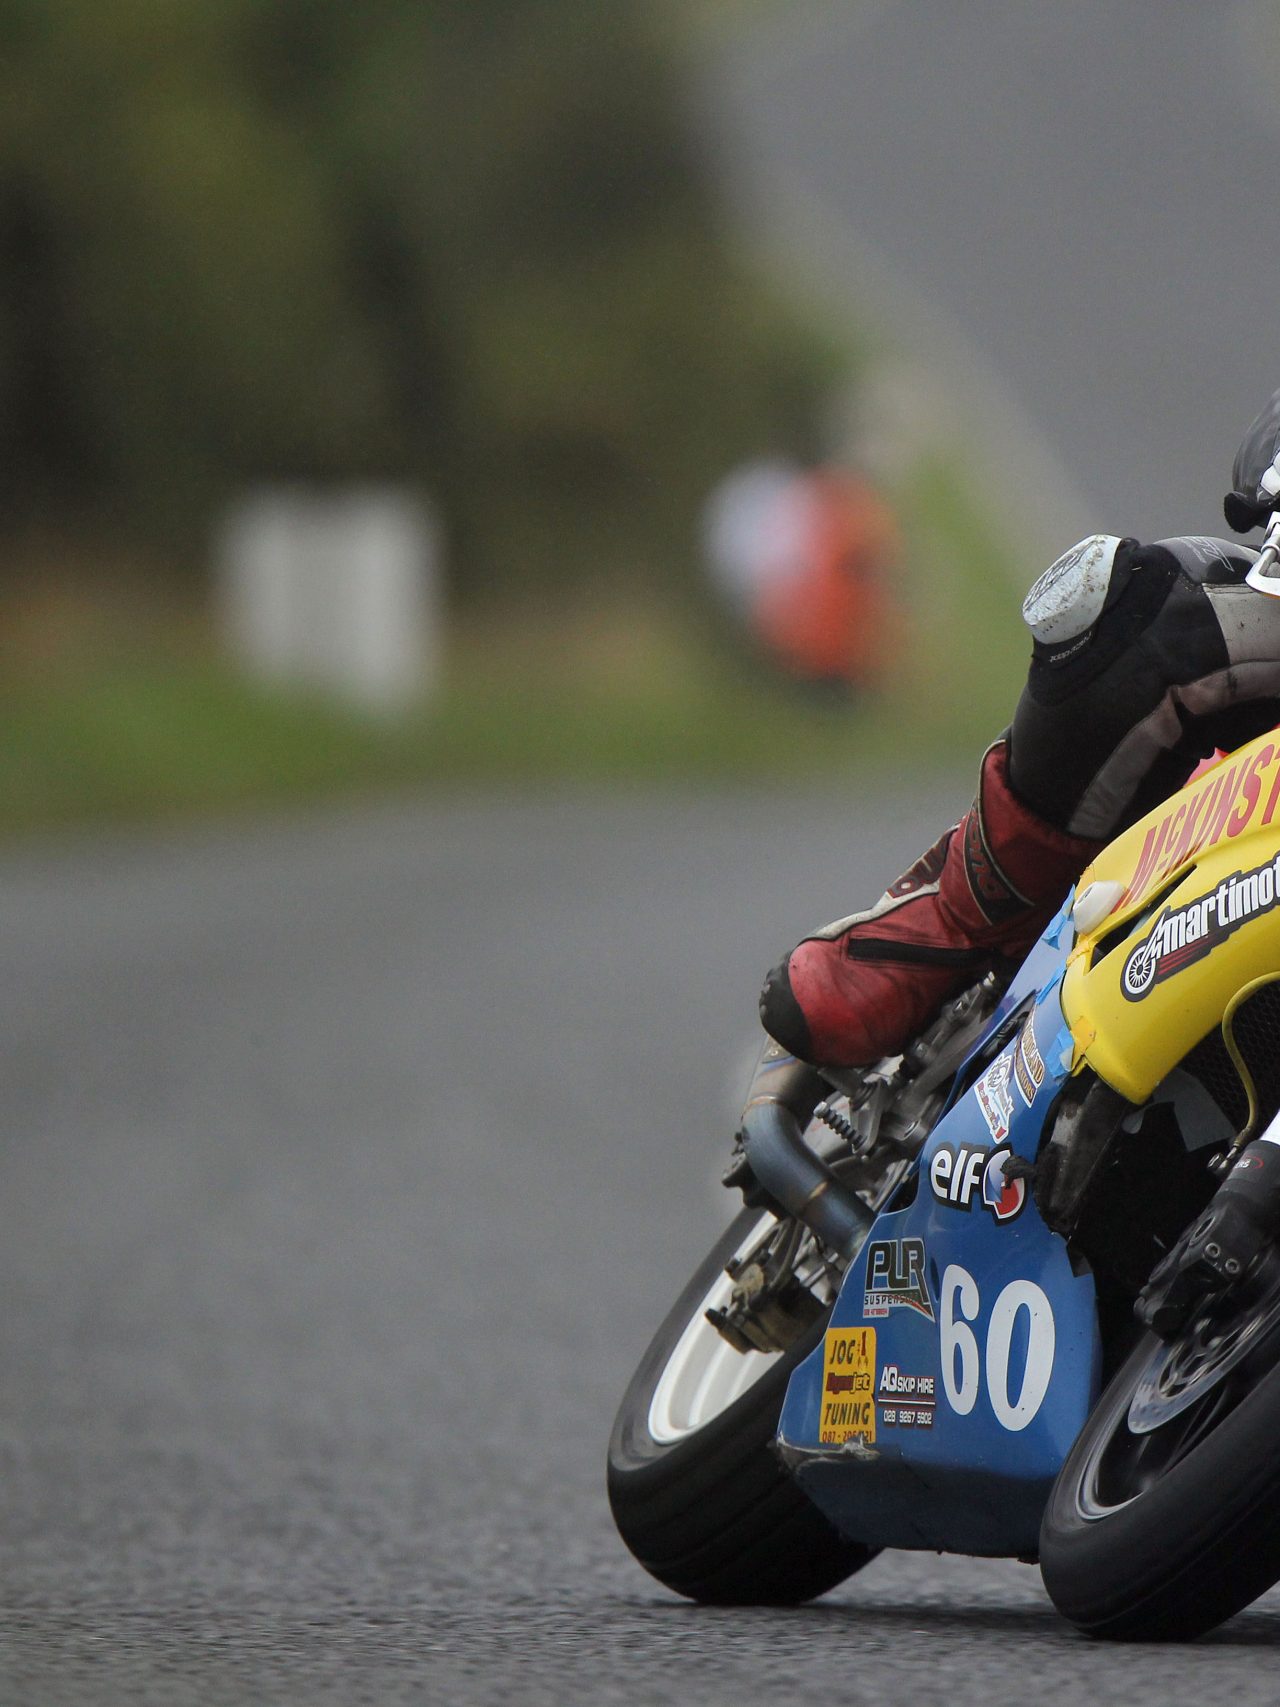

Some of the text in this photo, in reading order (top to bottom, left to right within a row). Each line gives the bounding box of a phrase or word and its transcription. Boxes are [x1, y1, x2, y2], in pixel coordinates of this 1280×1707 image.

[930, 1150, 985, 1204] elf
[865, 1238, 932, 1312] PLR
[829, 1339, 856, 1365] JOG
[940, 1264, 1056, 1432] 60
[898, 1376, 915, 1393] SKIP
[917, 1378, 934, 1394] HIRE
[823, 1402, 871, 1426] TUNING
